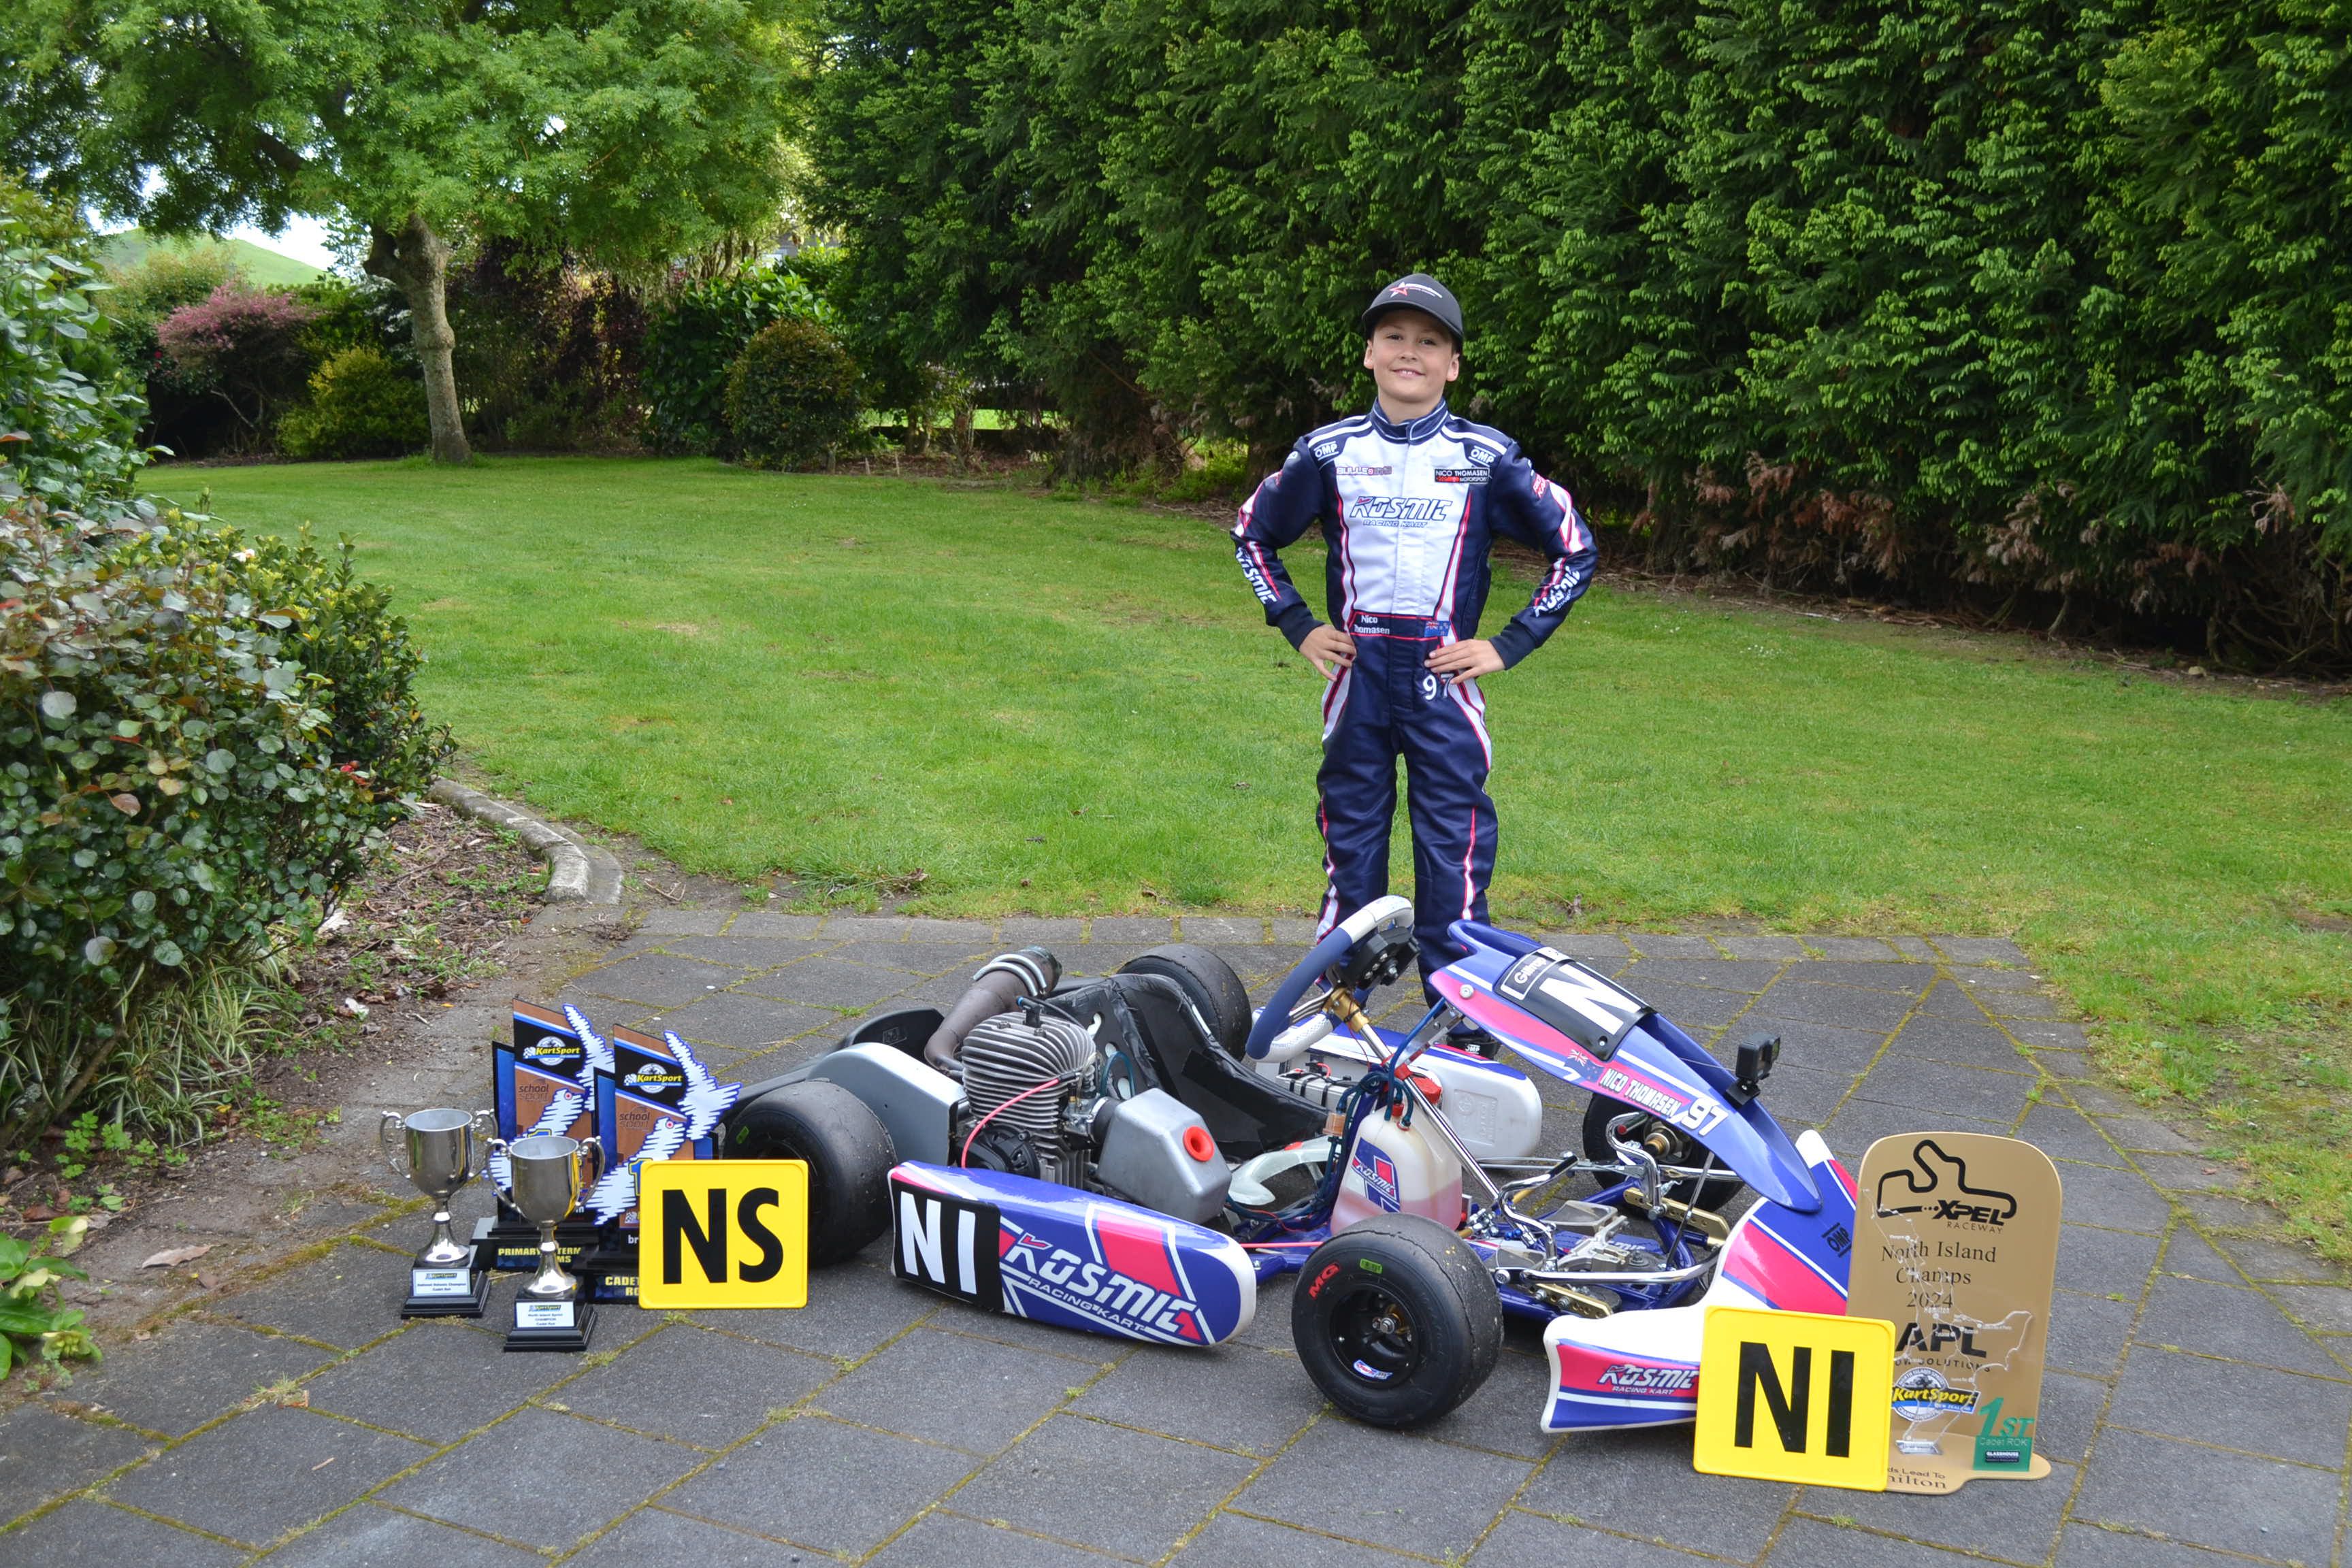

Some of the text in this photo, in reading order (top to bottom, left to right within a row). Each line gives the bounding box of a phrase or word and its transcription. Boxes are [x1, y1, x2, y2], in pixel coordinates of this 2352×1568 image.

[1314, 442, 1338, 459] OMP
[1470, 448, 1494, 464] OMP
[1350, 495, 1453, 521] KOSMIC
[1362, 519, 1399, 527] RACING
[1360, 615, 1378, 624] Nico
[1422, 672, 1455, 701] 97
[535, 1047, 581, 1056] KartSport
[519, 1083, 549, 1093] school
[636, 1074, 683, 1083] KartSport
[1599, 1068, 1683, 1117] NICO THOMASEN
[619, 1111, 651, 1121] school
[1681, 1096, 1729, 1137] 97
[1931, 1199, 2005, 1226] XPEL
[662, 1186, 784, 1285] NS
[1946, 1222, 2004, 1235] RACEWAY
[1880, 1241, 1997, 1263] North Island
[1004, 1232, 1198, 1333] KOSMIC
[1308, 1262, 1341, 1301] MG
[1895, 1265, 1972, 1286] Champs
[1028, 1277, 1145, 1333] RACING KART
[1906, 1291, 1953, 1308] 2024
[1895, 1322, 1987, 1359] APL
[1598, 1363, 1699, 1390] KOSMIC
[1612, 1386, 1647, 1394] RACING
[1734, 1341, 1855, 1458] NI
[1893, 1388, 1974, 1404] KartSport
[1902, 1468, 1930, 1477] Lead
[1932, 1471, 1946, 1480] To
